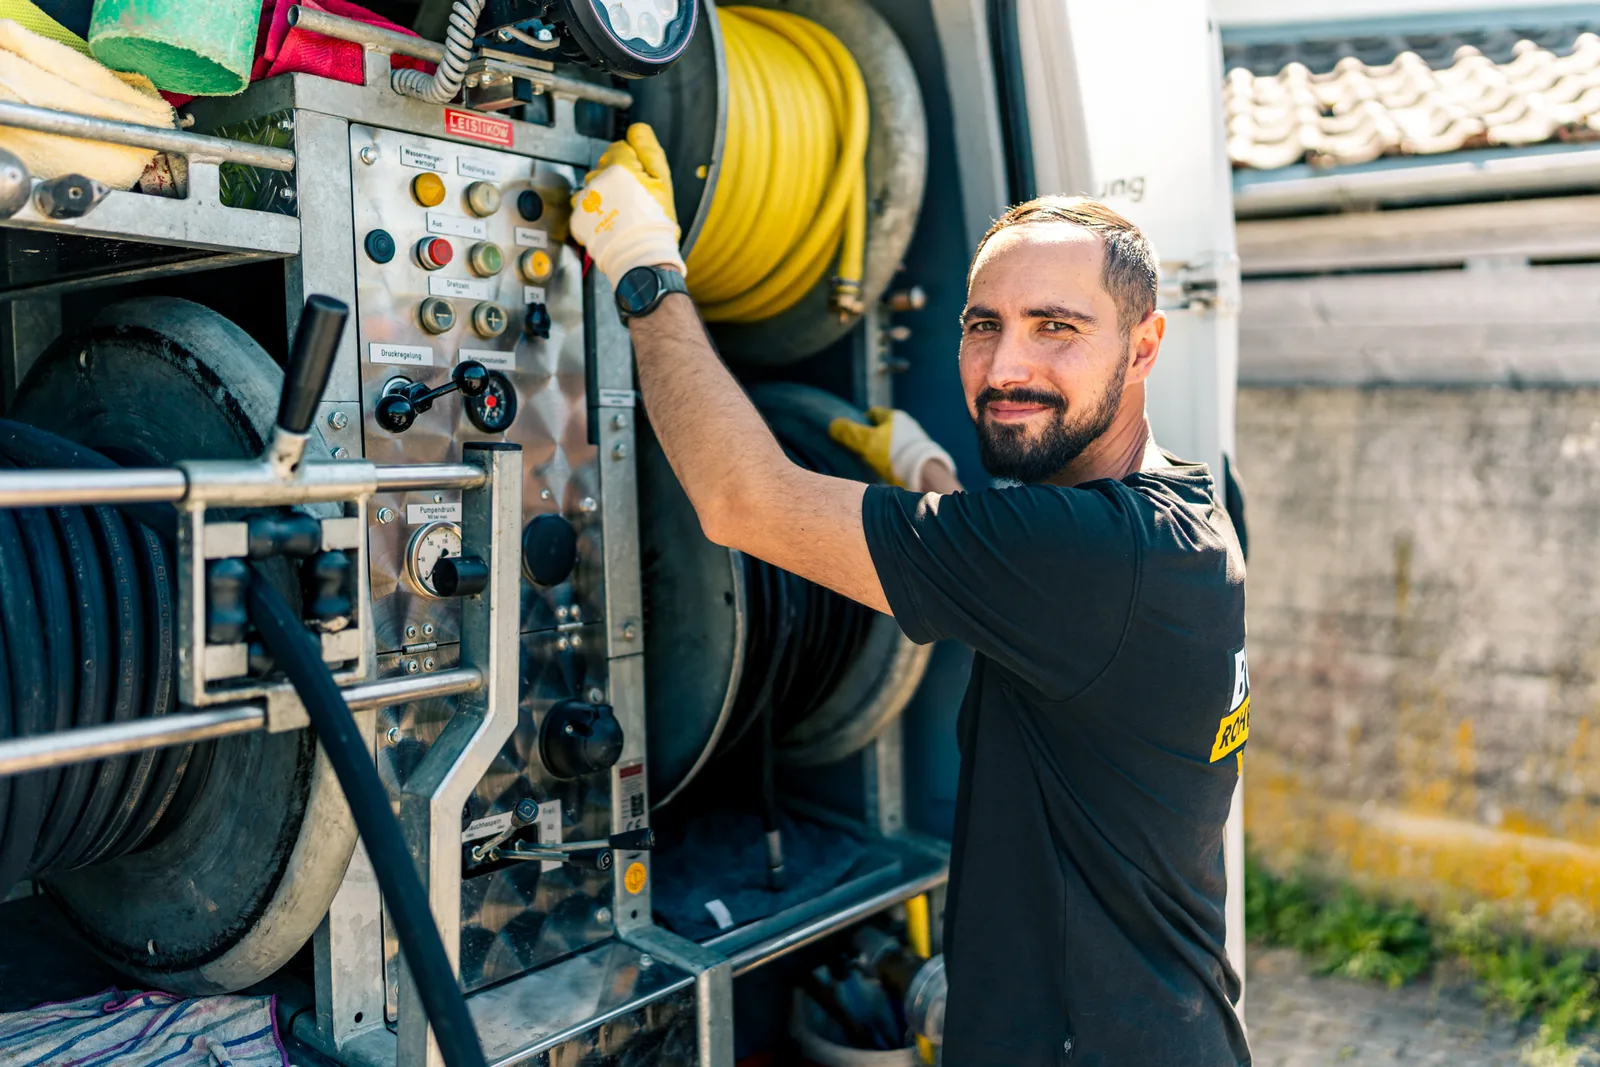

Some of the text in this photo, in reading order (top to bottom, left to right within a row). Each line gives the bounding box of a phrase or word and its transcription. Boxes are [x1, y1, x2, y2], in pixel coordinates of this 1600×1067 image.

[450, 115, 509, 139] LEISTIKOW
[415, 160, 436, 169] warnung
[1095, 176, 1145, 203] ung
[432, 220, 443, 228] Aus
[446, 280, 470, 290] Drehzahl
[381, 349, 422, 361] Druckregelung
[1229, 646, 1250, 712] B
